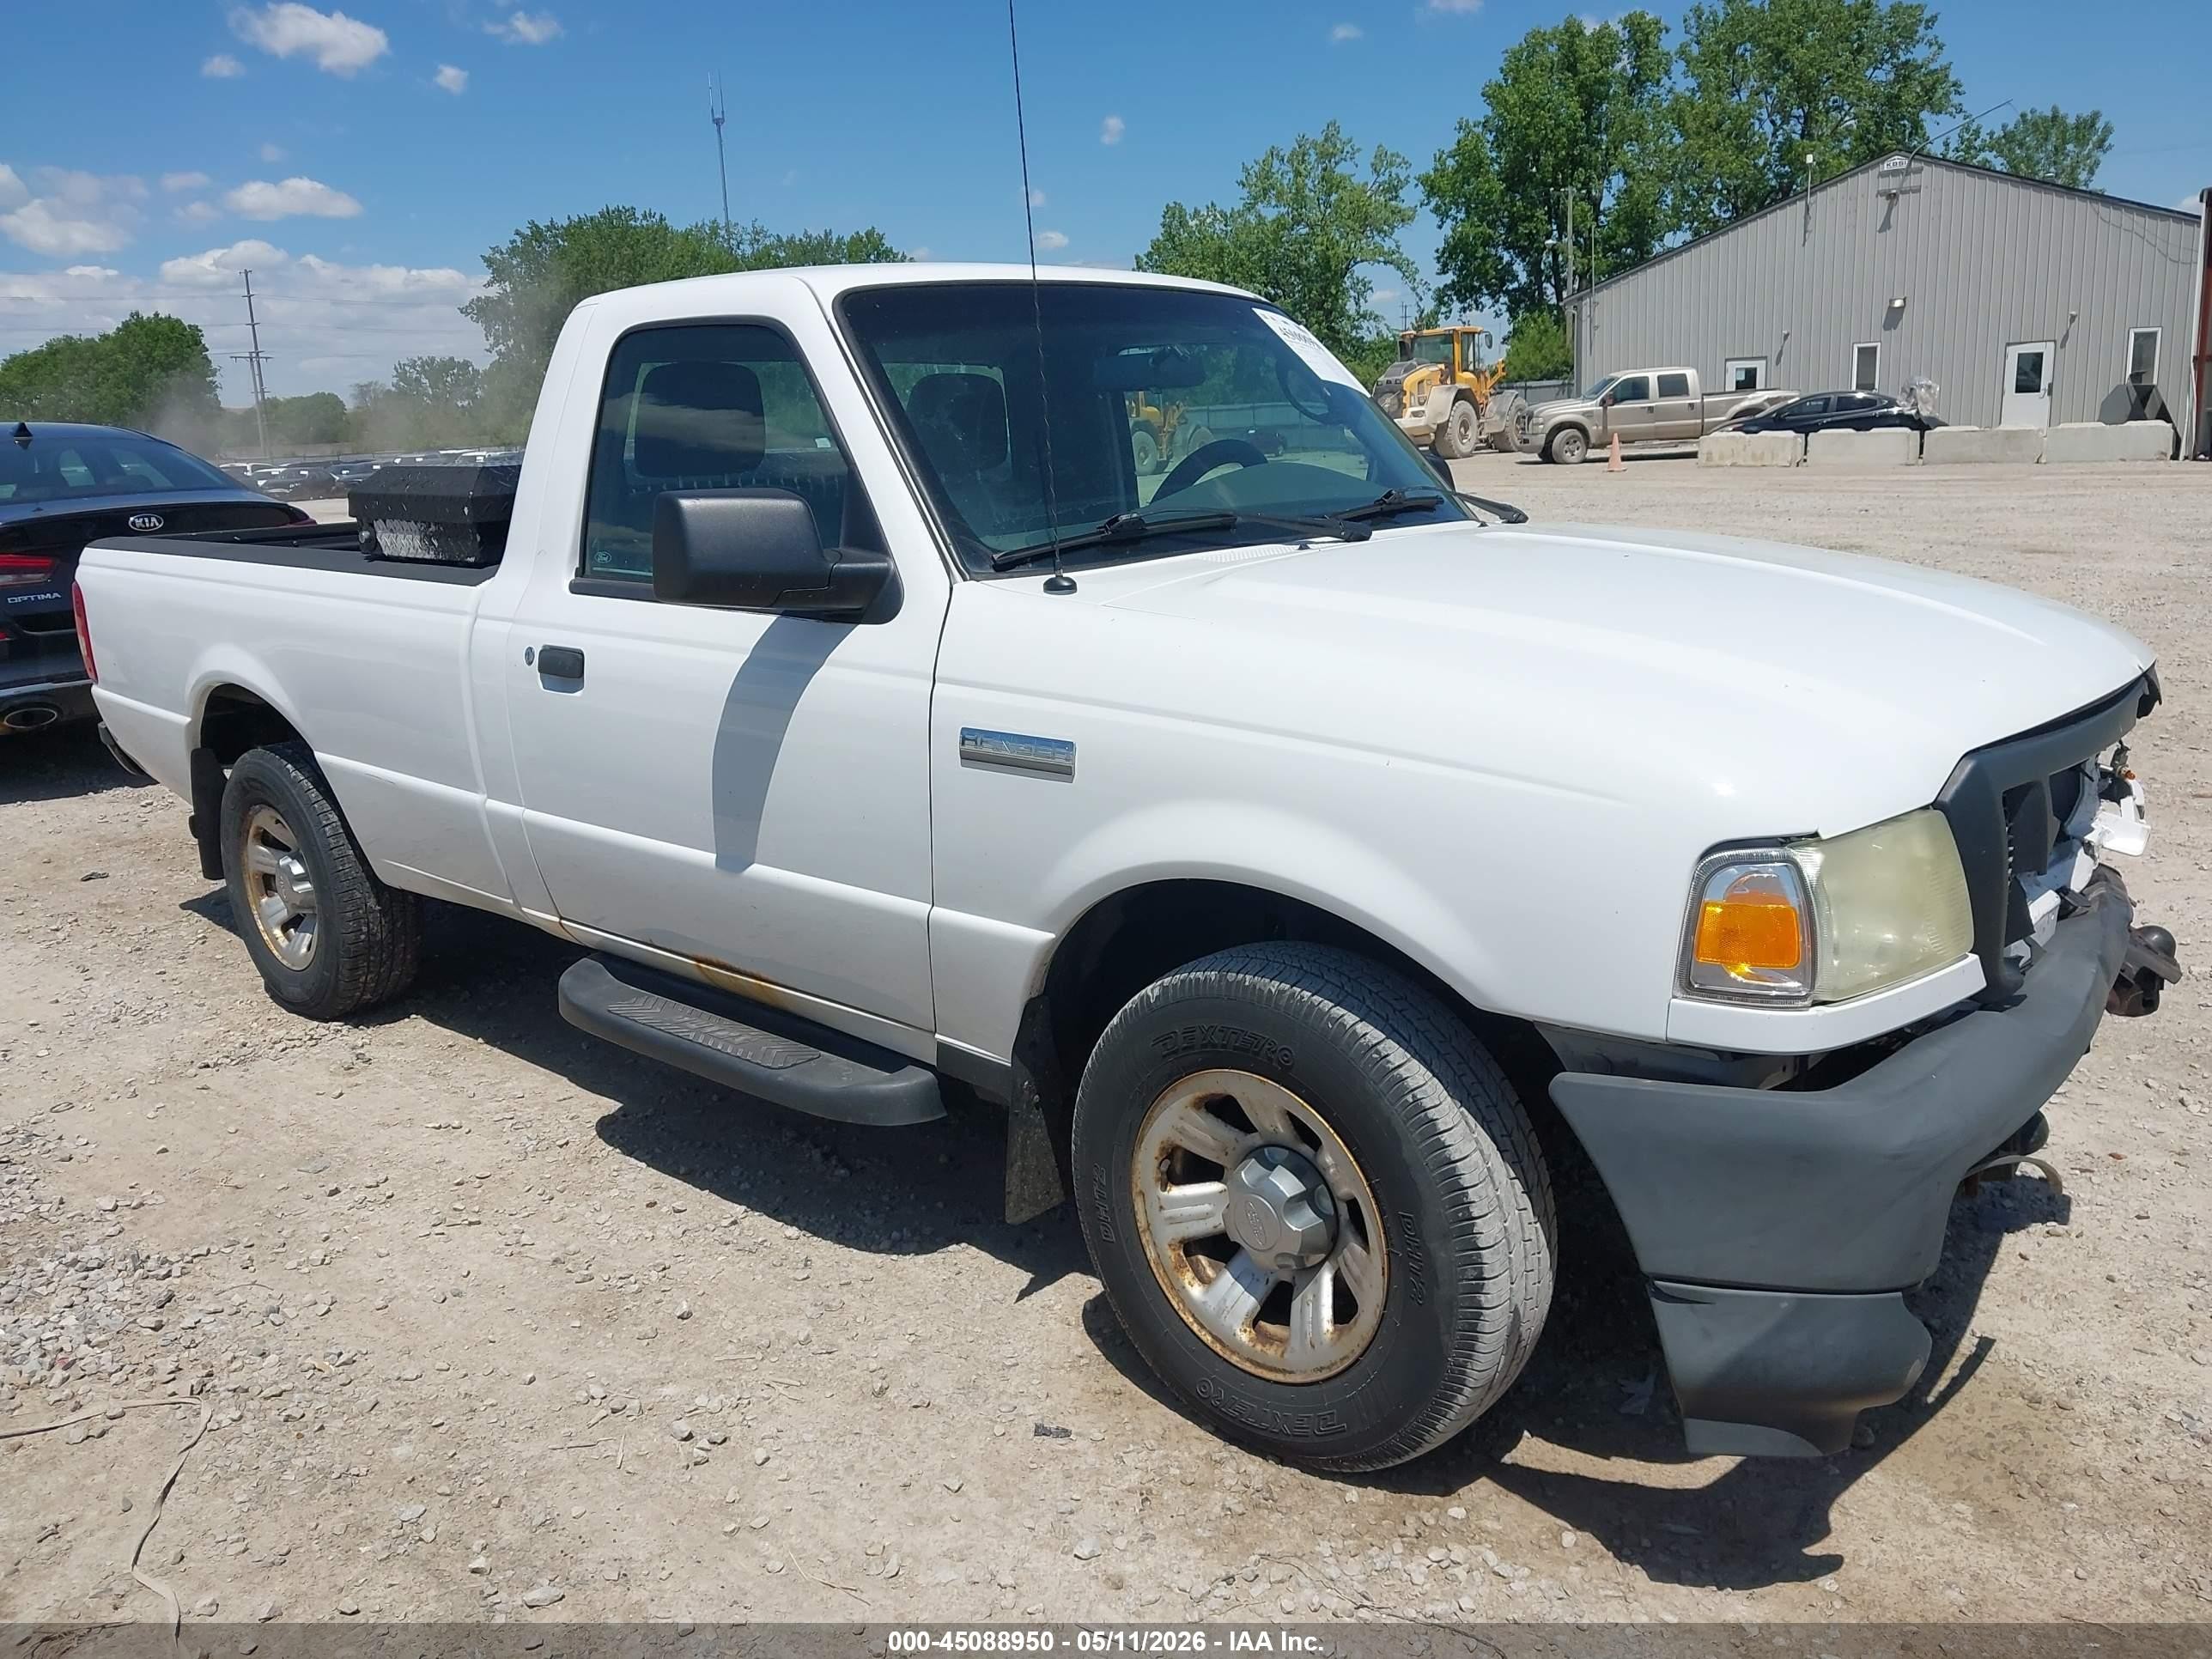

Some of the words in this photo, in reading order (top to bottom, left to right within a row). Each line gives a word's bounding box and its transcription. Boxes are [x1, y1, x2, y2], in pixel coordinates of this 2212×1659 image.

[133, 516, 161, 530] KIA
[6, 592, 63, 605] OPTIMA
[1149, 1024, 1297, 1068] DEXTERO
[1091, 1162, 1116, 1243] DHT2
[1195, 1376, 1347, 1438] DEXTERO
